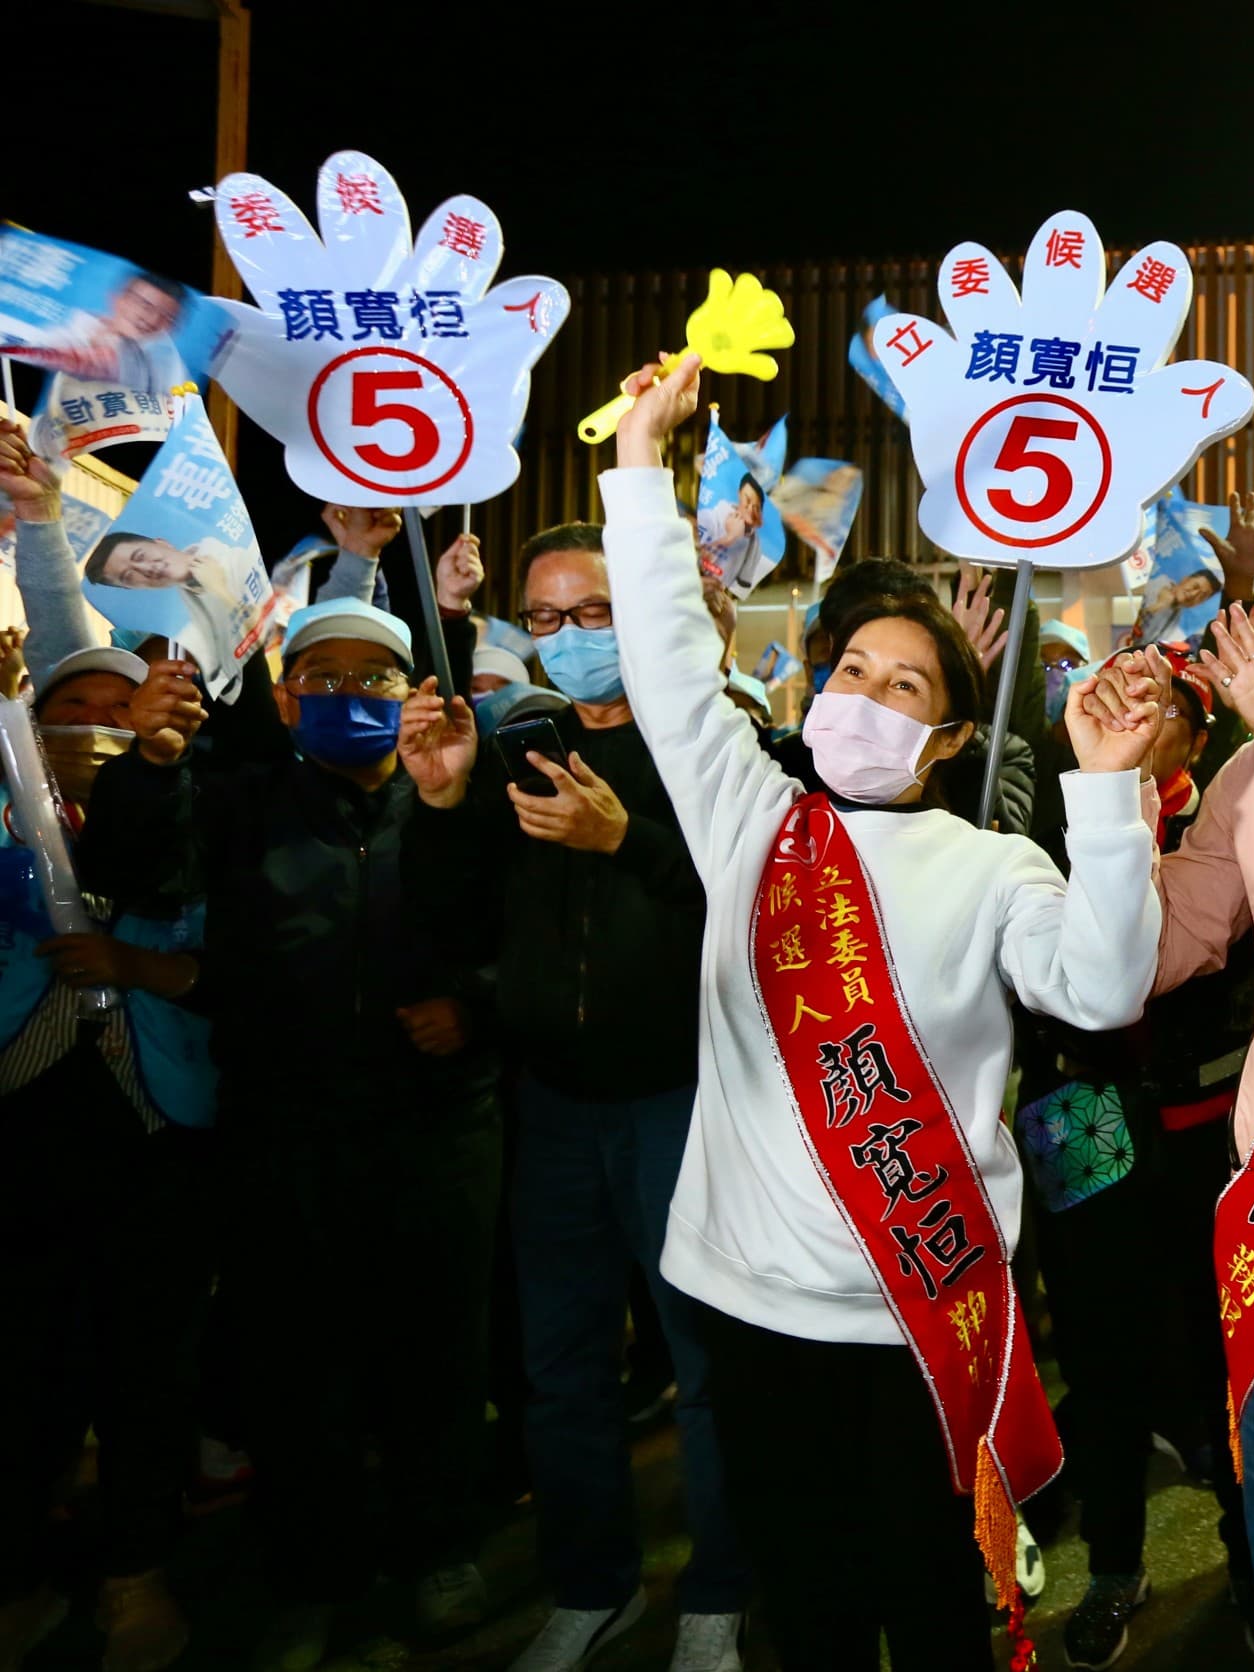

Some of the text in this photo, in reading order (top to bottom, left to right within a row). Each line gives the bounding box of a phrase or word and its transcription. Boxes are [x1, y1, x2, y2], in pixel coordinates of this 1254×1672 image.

[277, 288, 469, 341] 顏寬恒
[964, 330, 1141, 394] 顏寬恒
[768, 872, 832, 1035] 候選人
[814, 864, 874, 1013] 立法委員
[816, 1023, 985, 1300] 顏寬恒
